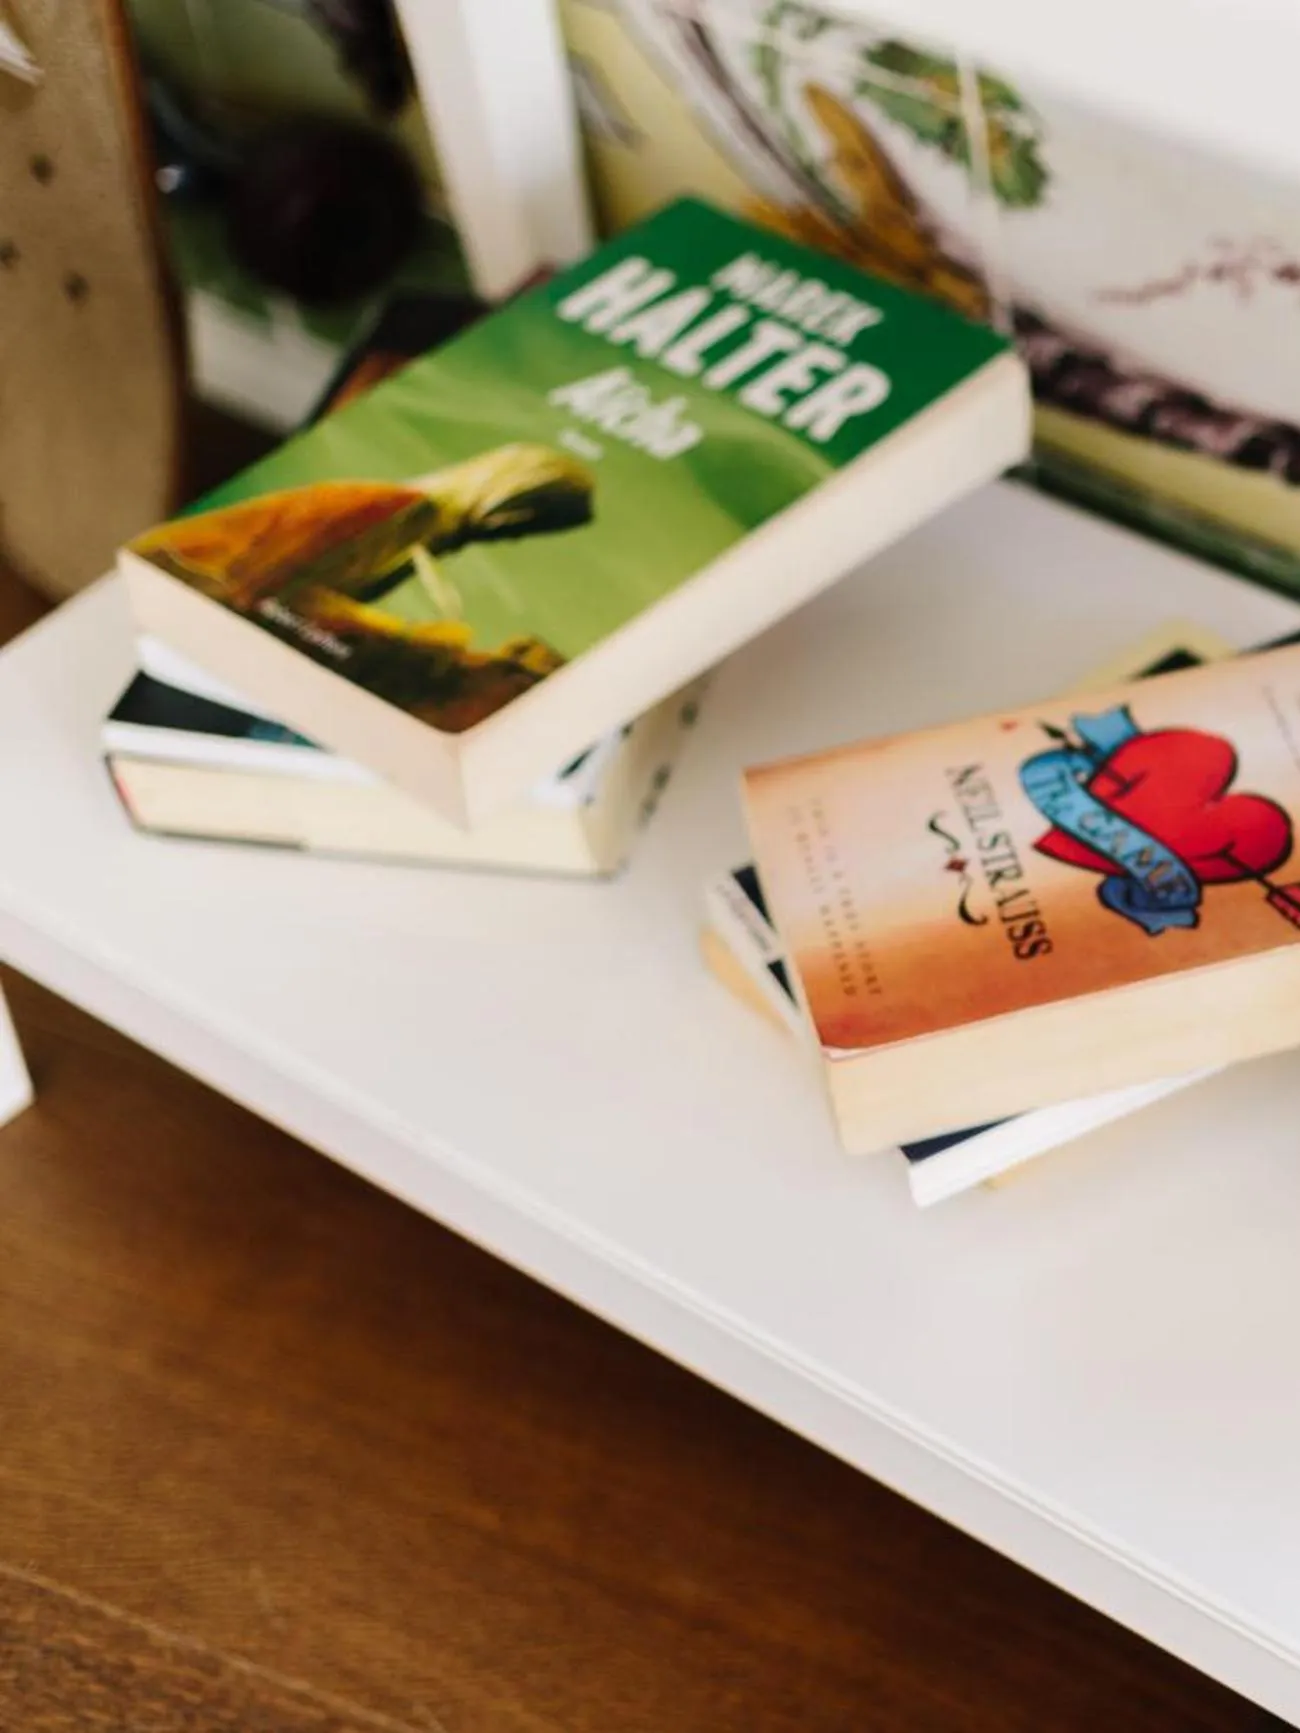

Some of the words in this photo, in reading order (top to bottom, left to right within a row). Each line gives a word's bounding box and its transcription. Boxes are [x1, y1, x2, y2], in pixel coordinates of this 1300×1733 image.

[556, 254, 892, 442] HALTER
[945, 763, 1002, 832] NEIL
[976, 830, 1054, 961] STRAUSS
